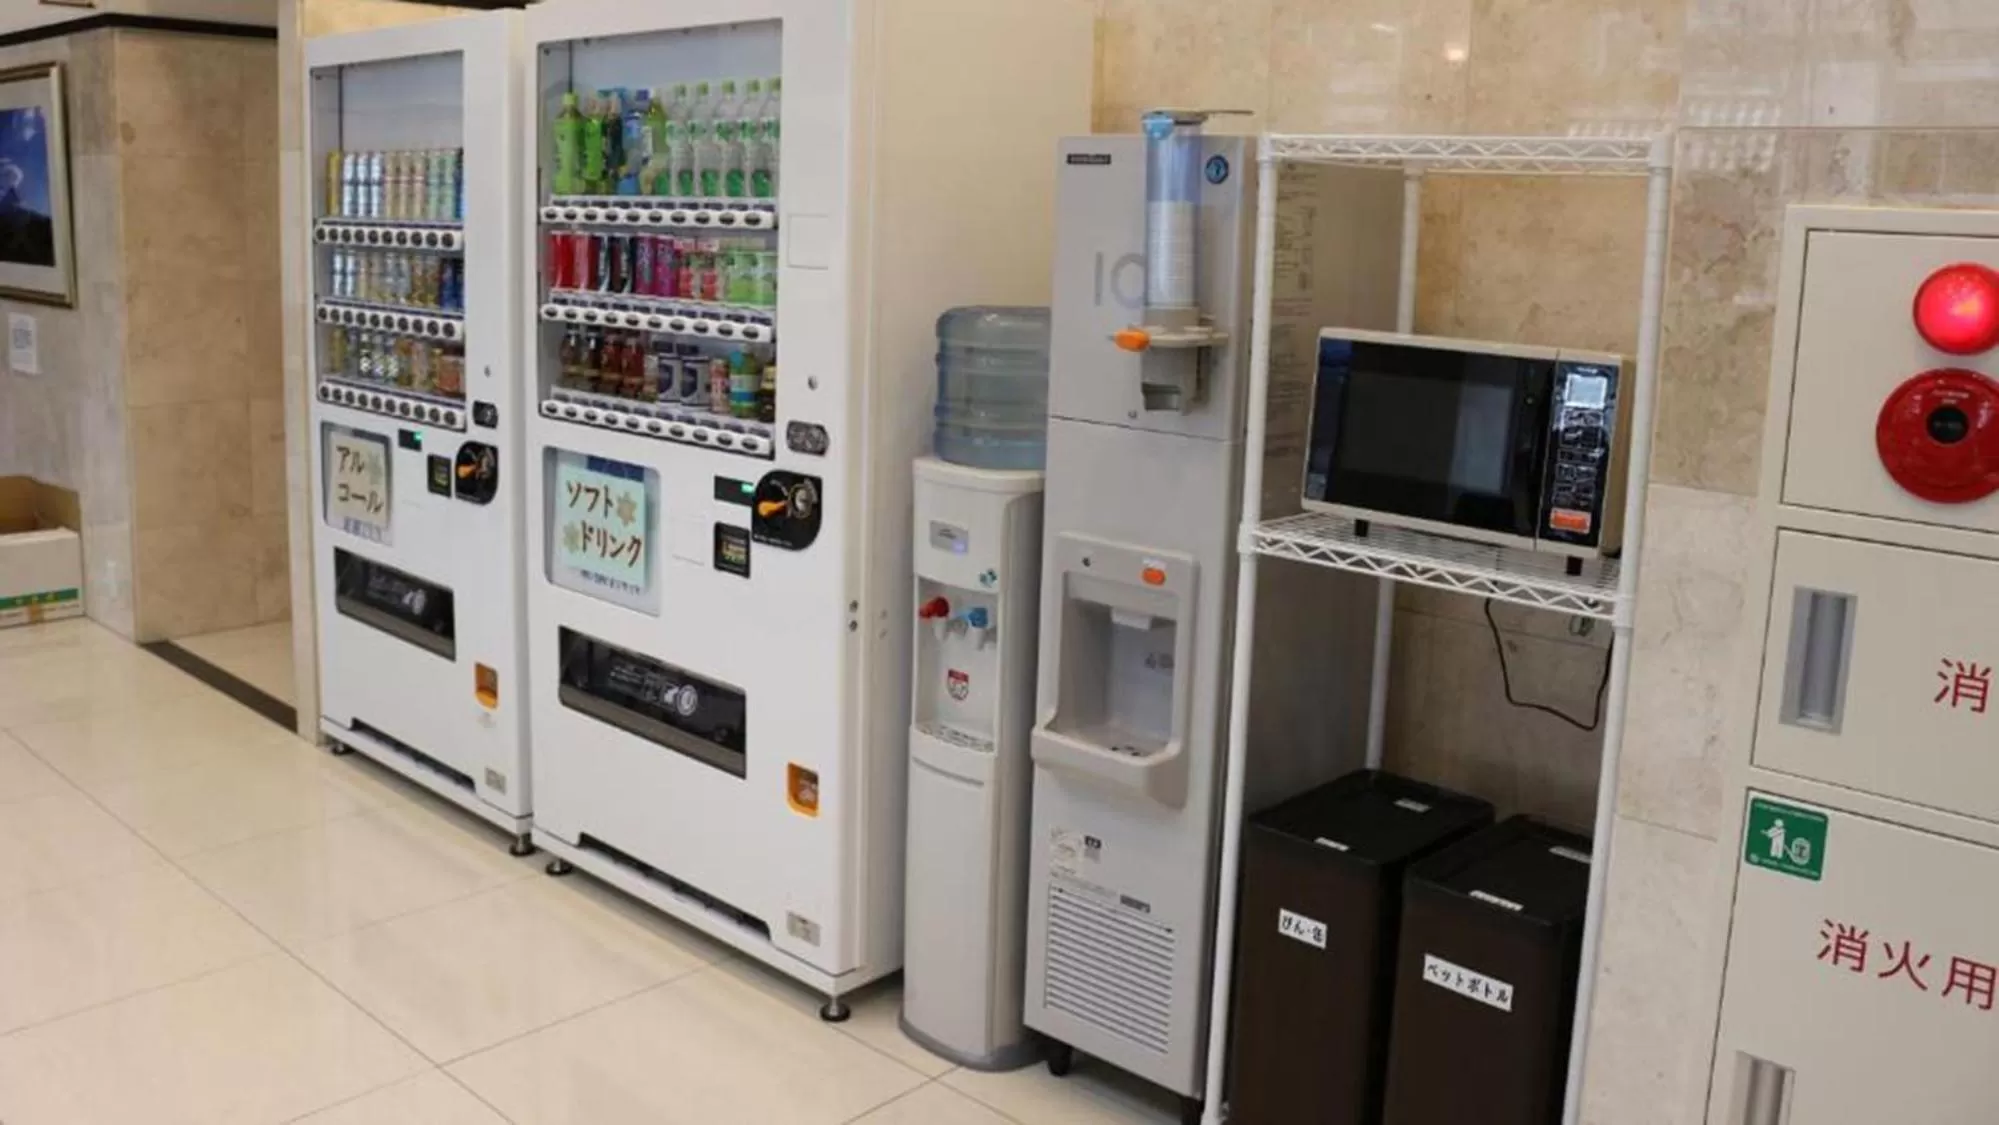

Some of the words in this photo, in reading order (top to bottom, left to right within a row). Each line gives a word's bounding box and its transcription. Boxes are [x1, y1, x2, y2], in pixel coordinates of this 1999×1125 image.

[336, 446, 365, 473] アル
[337, 483, 384, 513] コール
[566, 480, 613, 519] ソフト
[581, 520, 642, 568] ドリンク
[1934, 657, 1991, 713] 消
[1427, 963, 1508, 1003] ペットボトル
[1817, 918, 1997, 1010] 消火用
